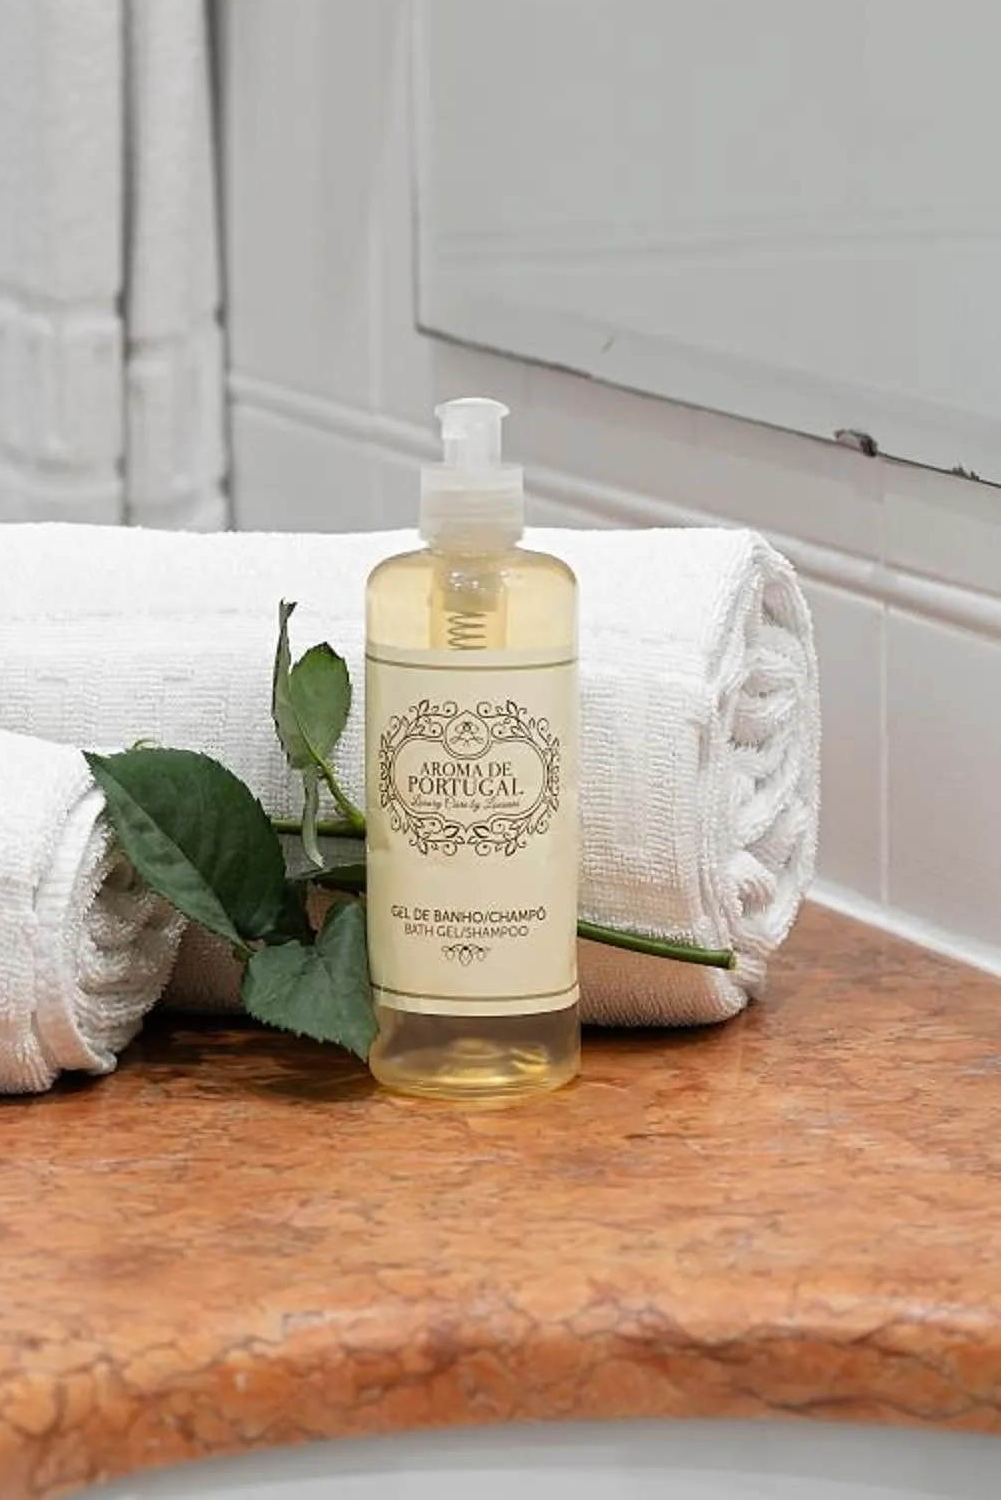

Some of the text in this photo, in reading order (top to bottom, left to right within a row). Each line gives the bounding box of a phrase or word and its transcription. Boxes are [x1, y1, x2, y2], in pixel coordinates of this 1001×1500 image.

[420, 761, 514, 777] AROMA DE
[408, 775, 524, 797] PORTUGAL
[391, 904, 410, 919] GEL
[413, 907, 431, 921] DE
[404, 923, 529, 939] BATH GEL/SHAMPOO
